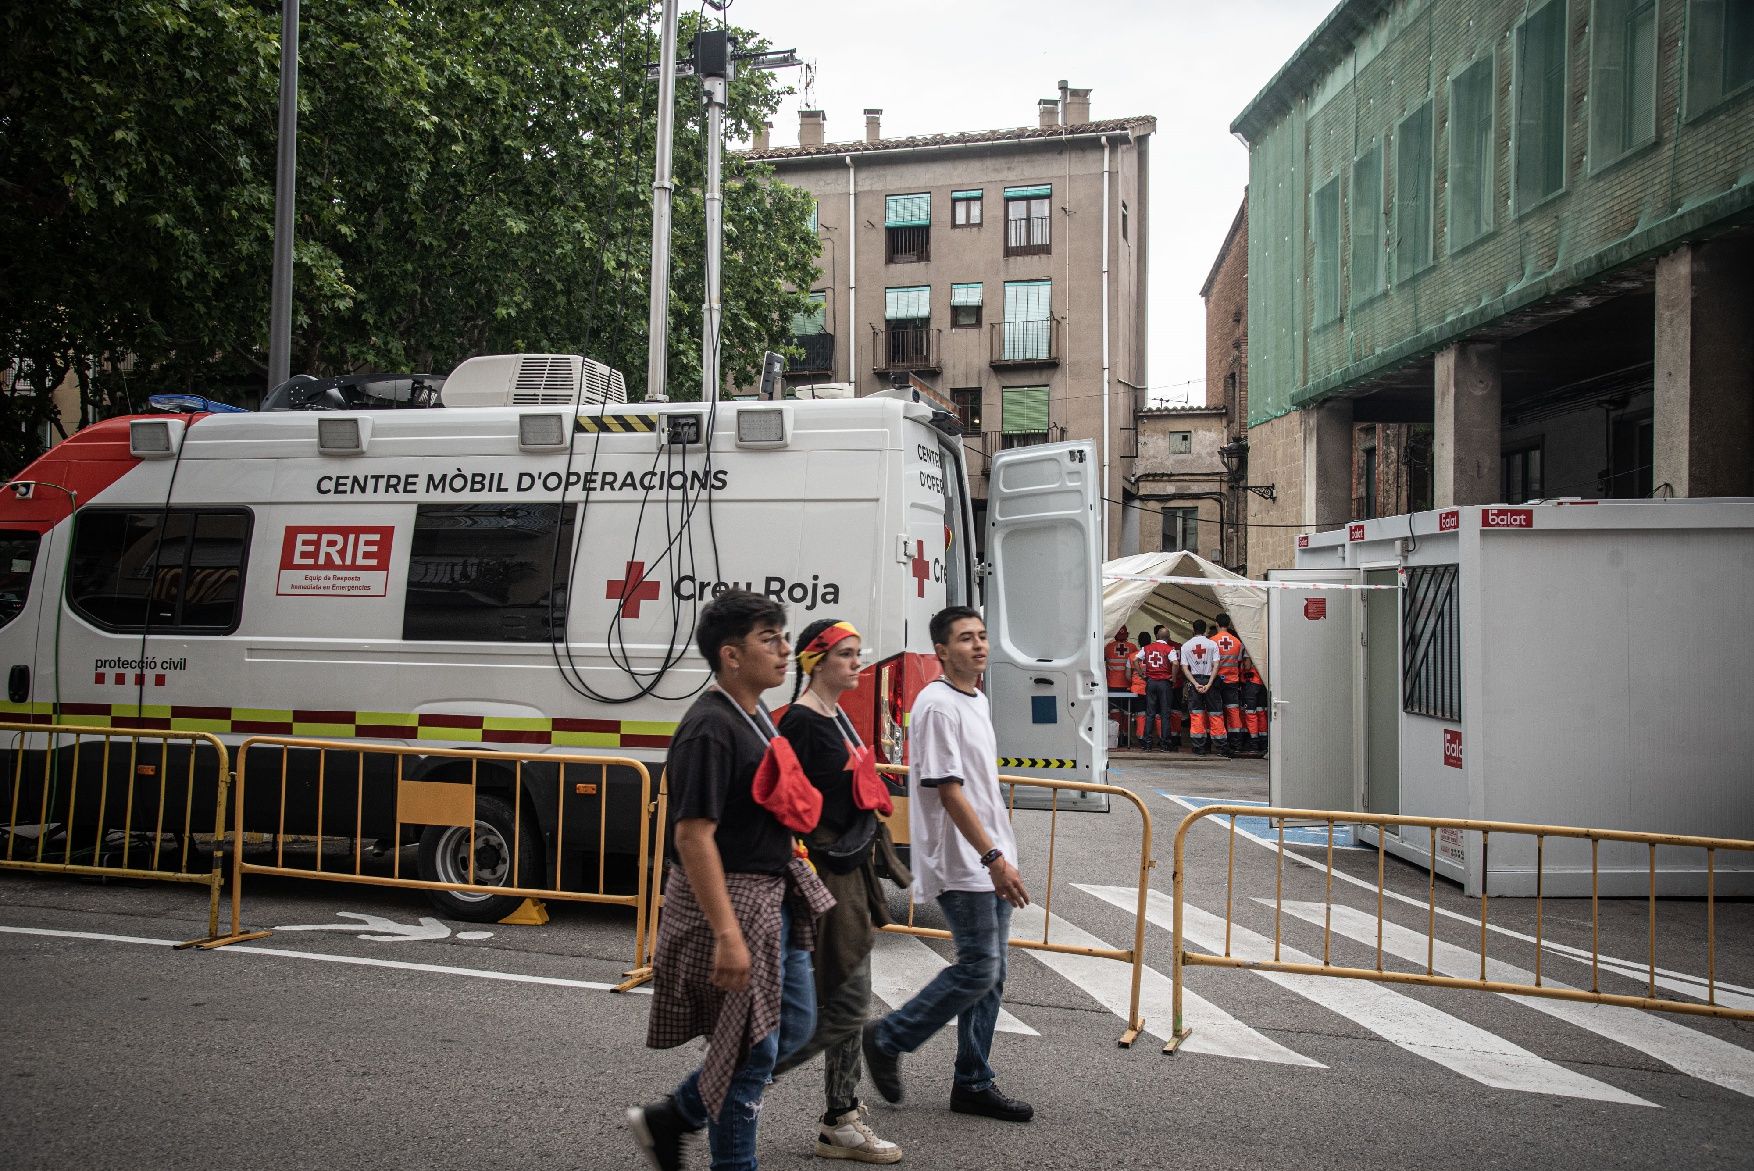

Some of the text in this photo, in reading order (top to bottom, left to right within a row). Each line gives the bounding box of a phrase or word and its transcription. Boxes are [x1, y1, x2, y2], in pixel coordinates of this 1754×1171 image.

[316, 467, 728, 495] CENTRE MÒBIL D'OPERACIONS
[1488, 508, 1526, 525] balat
[292, 533, 381, 566] ERIE
[304, 574, 322, 582] Equip
[332, 574, 361, 582] Resposta
[764, 574, 840, 611] Roja
[94, 655, 187, 671] protecció civil
